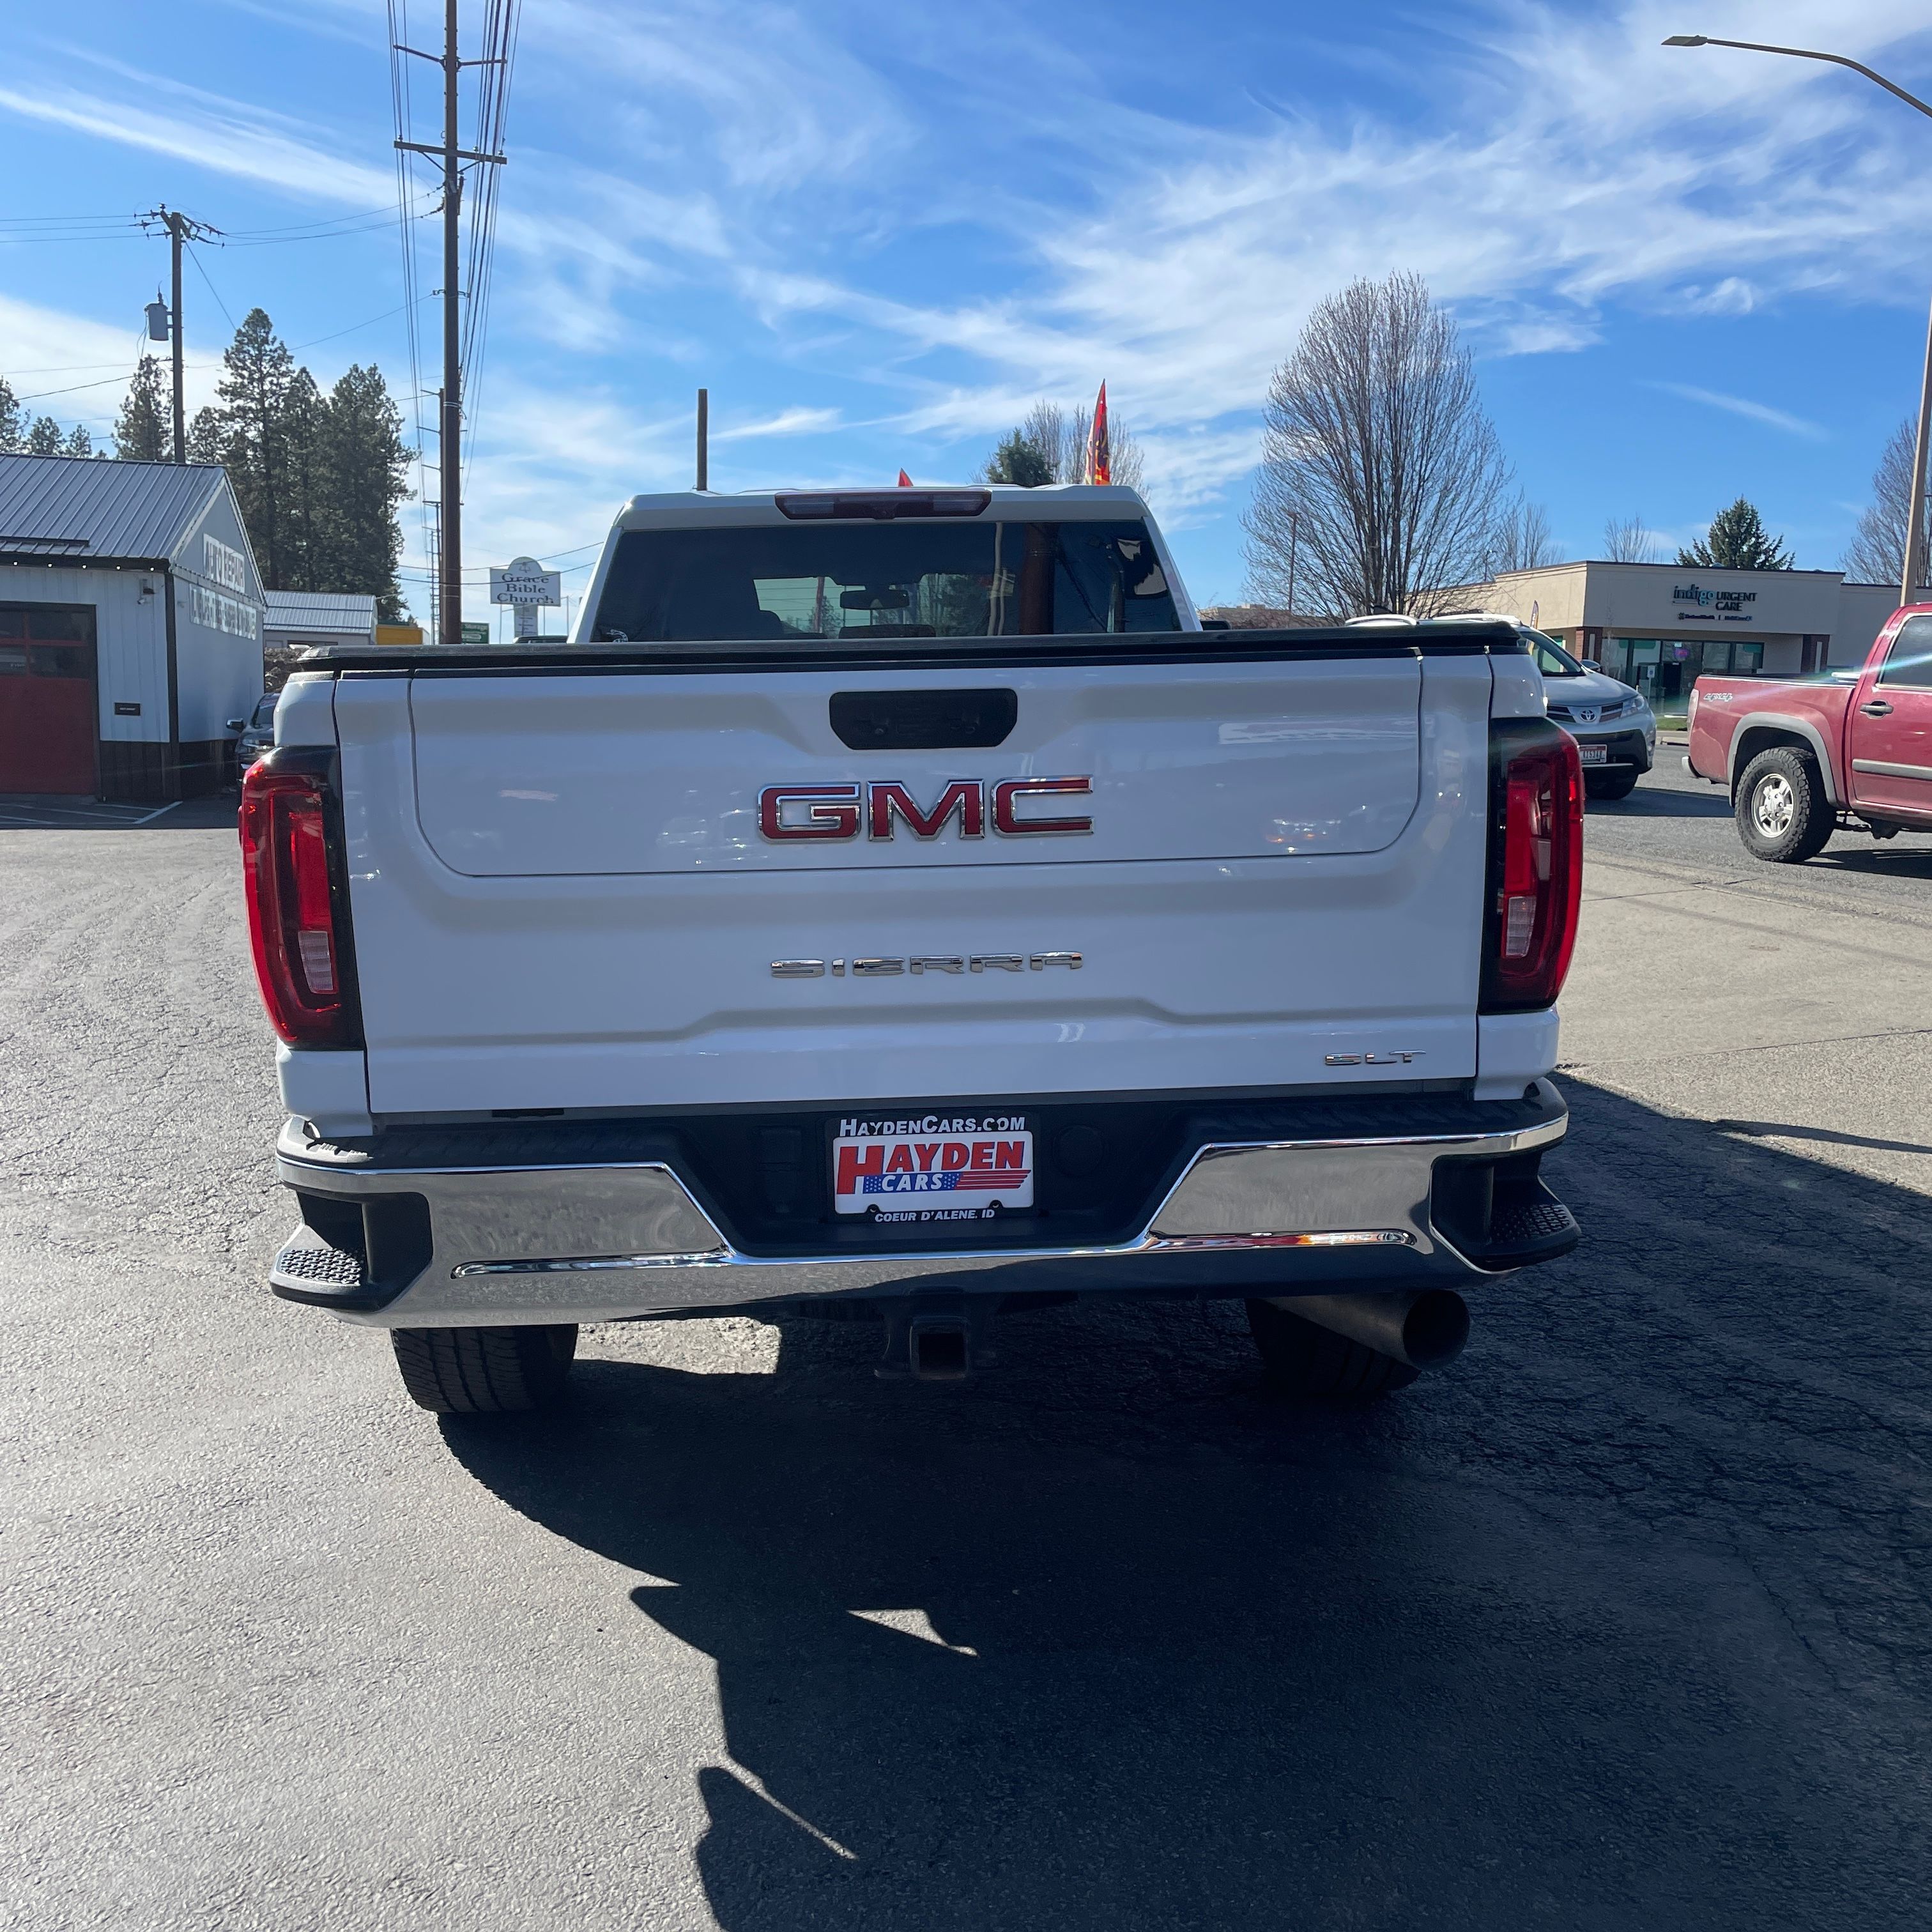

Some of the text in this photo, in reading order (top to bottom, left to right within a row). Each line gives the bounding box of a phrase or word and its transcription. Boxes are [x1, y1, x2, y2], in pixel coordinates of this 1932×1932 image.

[502, 573, 549, 584] Grace
[506, 583, 546, 594] Bible
[1673, 584, 1758, 606] indigo URGENT
[497, 593, 554, 604] Church
[1715, 601, 1744, 611] CARE
[757, 774, 1094, 844] GMC
[771, 951, 1084, 978] SIERRA
[1325, 1050, 1427, 1066] SLT
[836, 1140, 1025, 1195] HAYDEN
[882, 1173, 944, 1192] CARS
[875, 1212, 916, 1223] COEUR
[981, 1209, 995, 1219] ID
